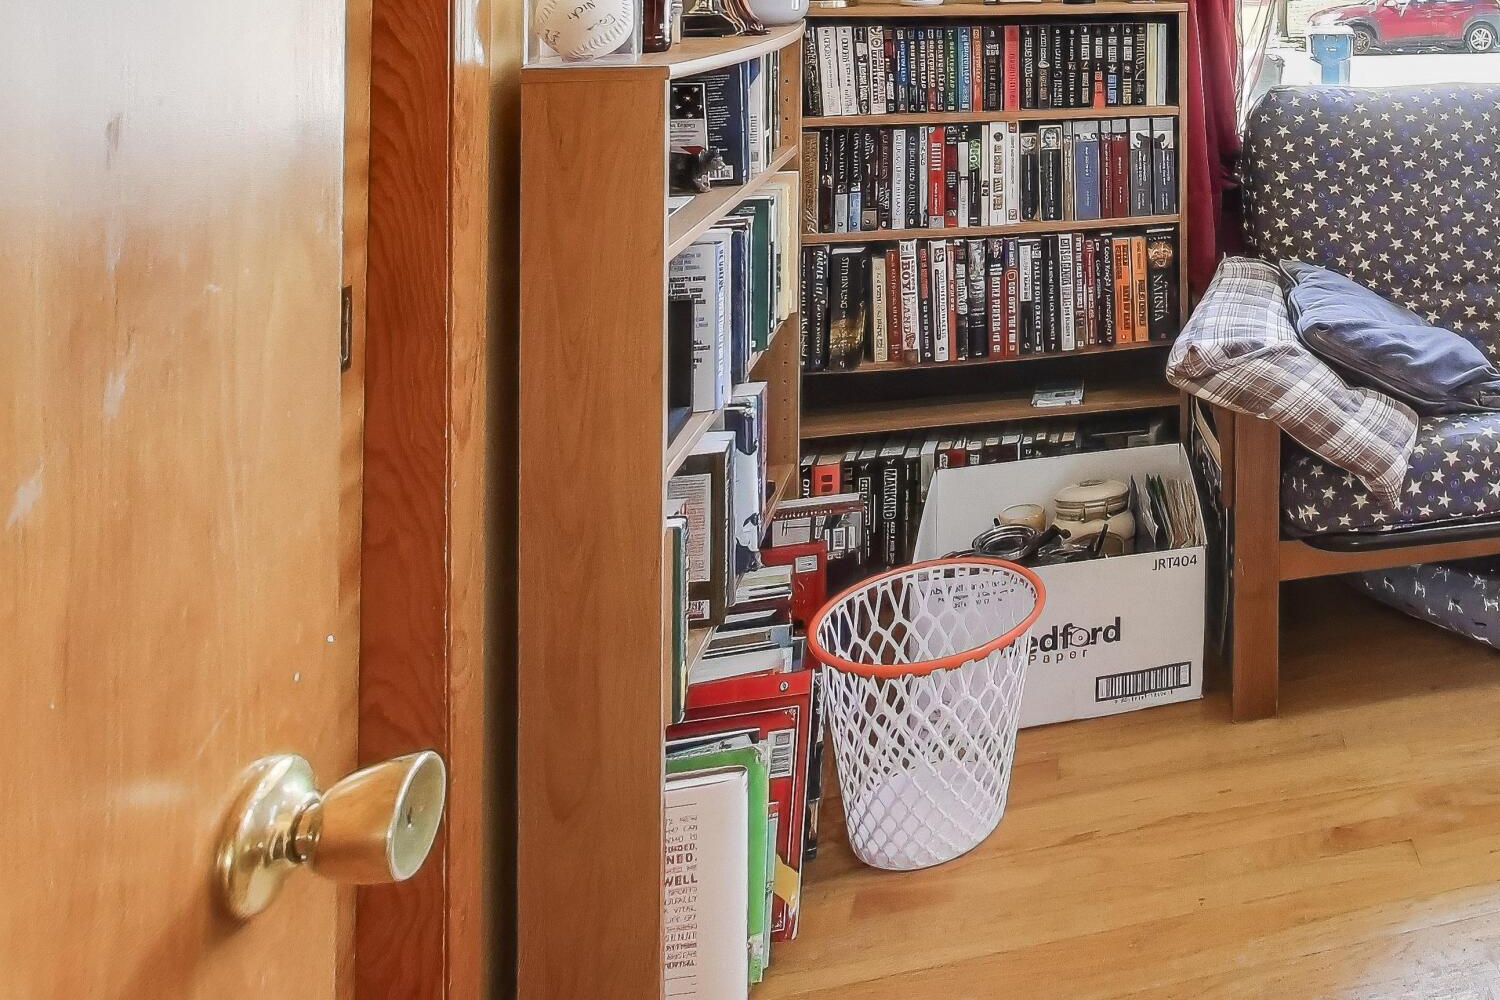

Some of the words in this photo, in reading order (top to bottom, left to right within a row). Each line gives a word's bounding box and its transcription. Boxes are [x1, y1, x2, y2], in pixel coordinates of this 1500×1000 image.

[902, 261, 911, 290] BOY
[1153, 274, 1165, 322] NARNIA
[883, 468, 897, 520] MANKIND
[1151, 554, 1198, 571] JRT404
[1001, 616, 1121, 659] edford
